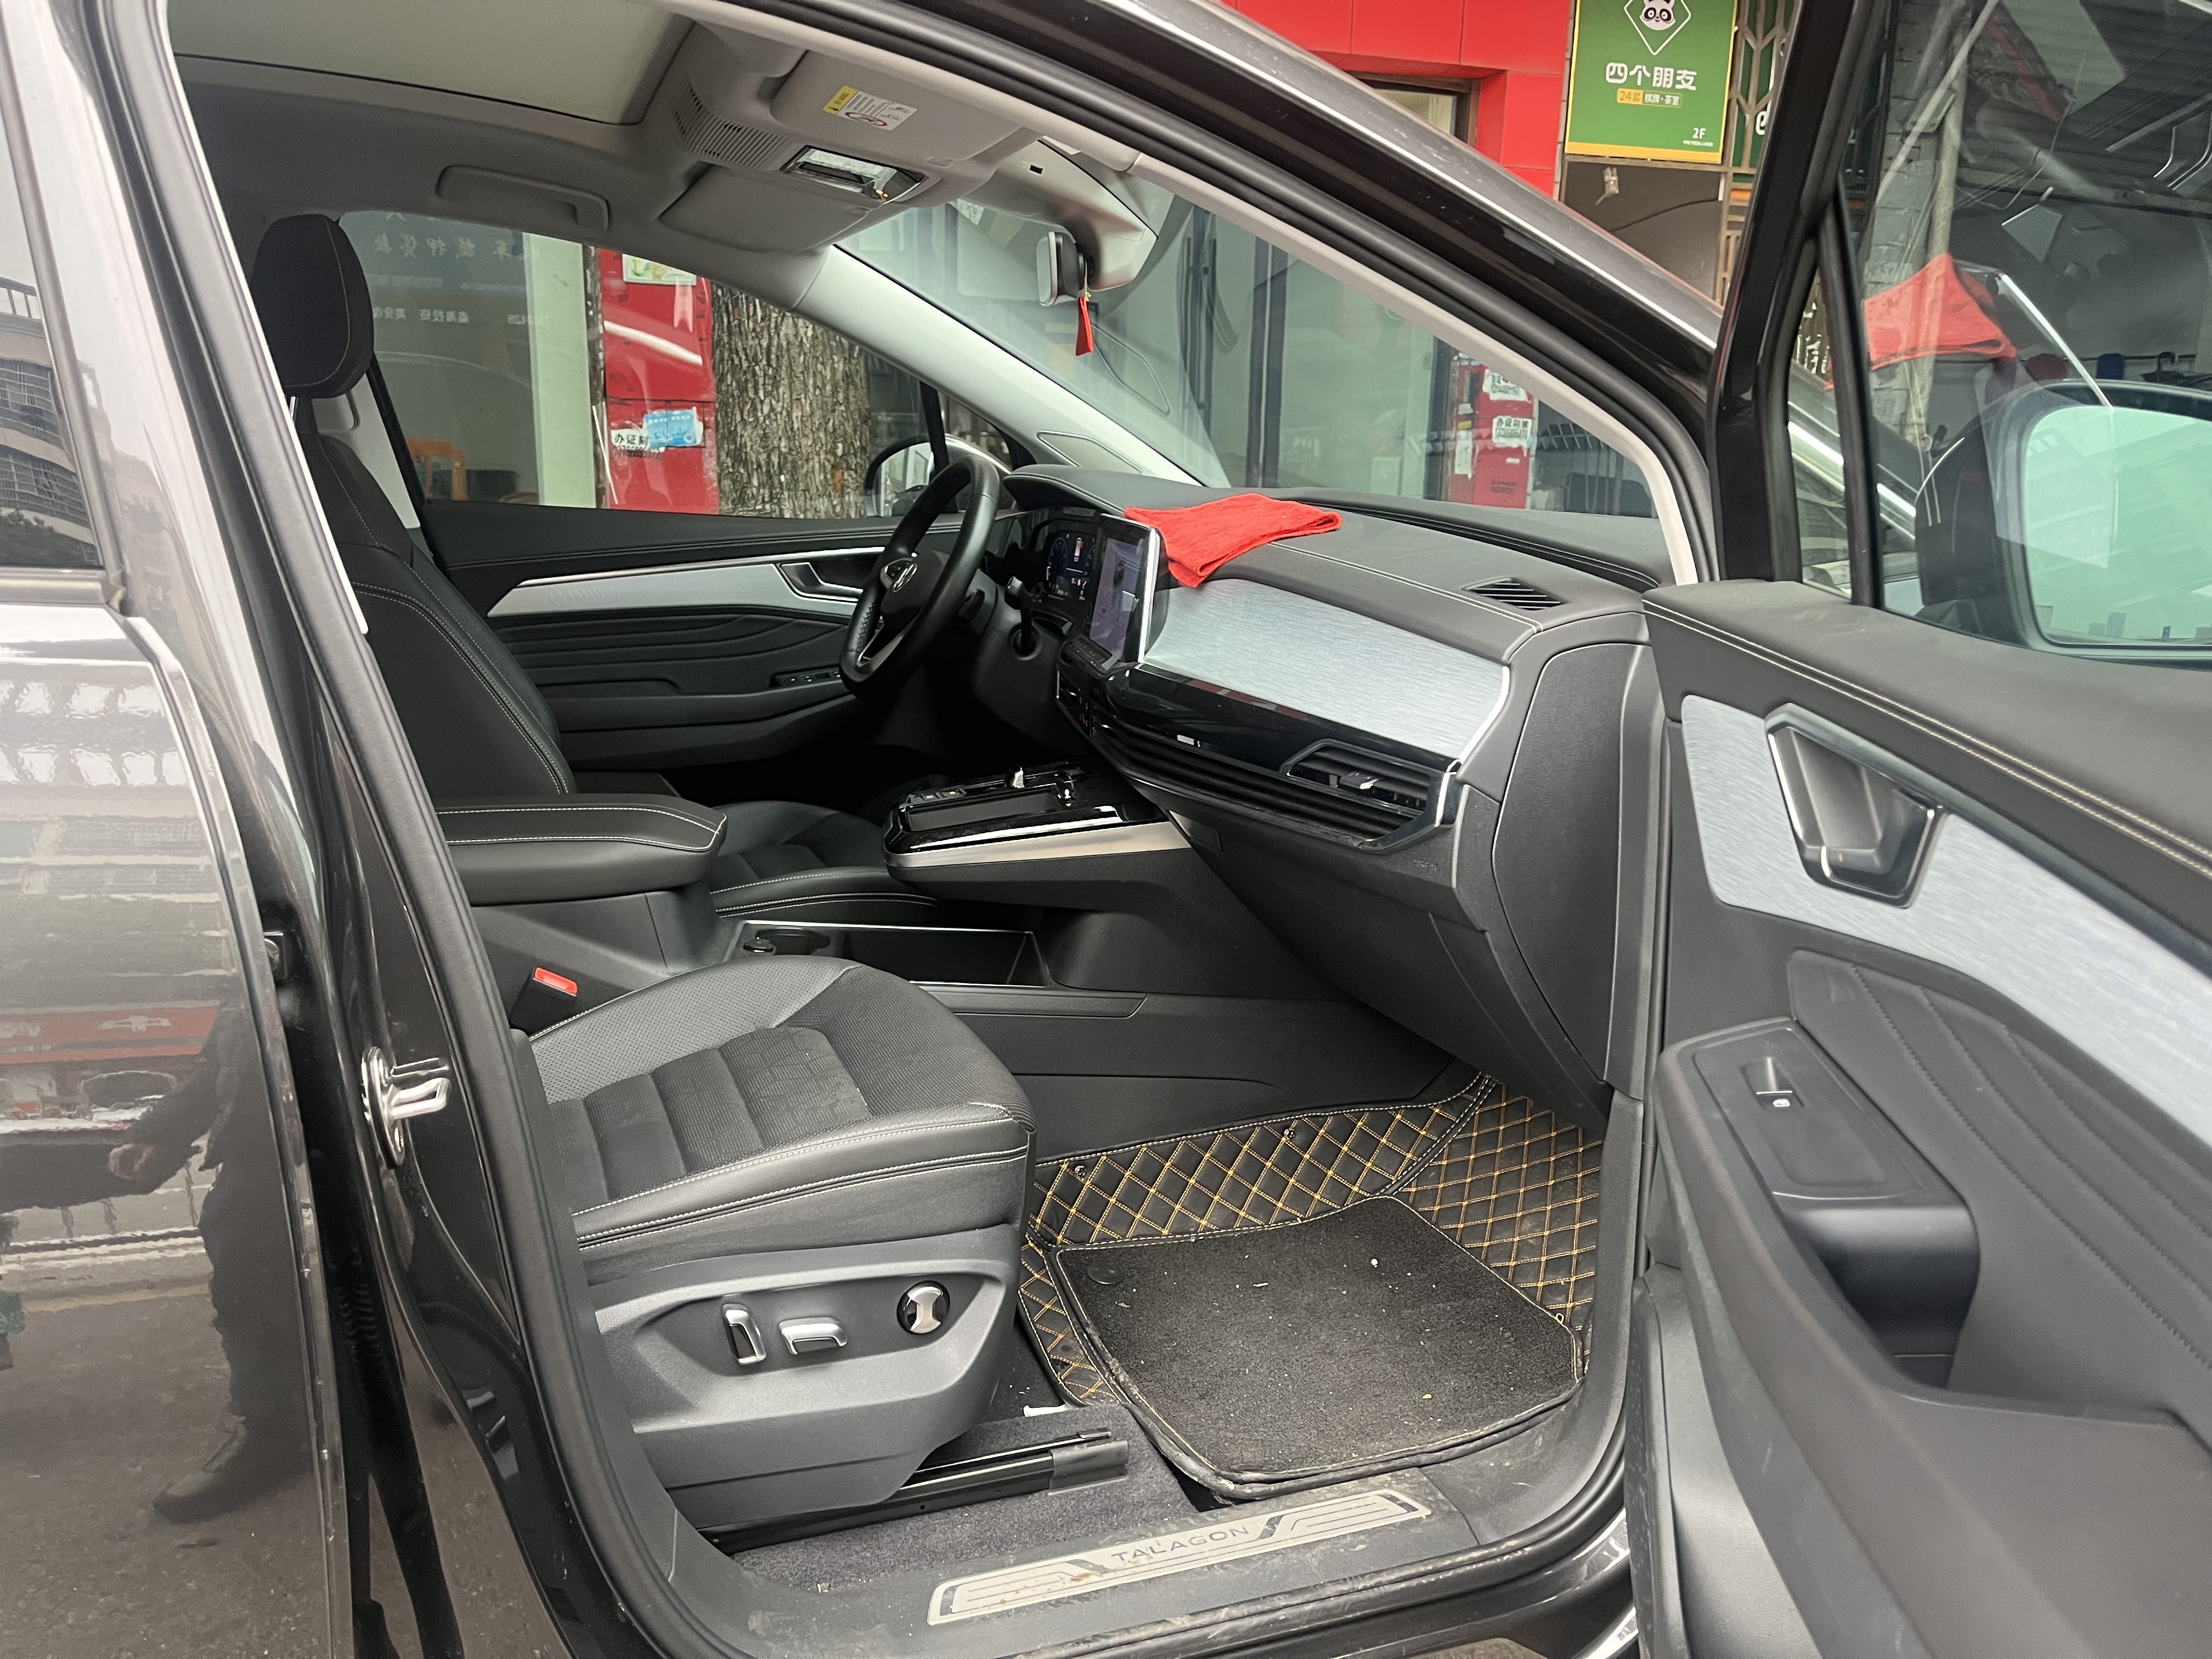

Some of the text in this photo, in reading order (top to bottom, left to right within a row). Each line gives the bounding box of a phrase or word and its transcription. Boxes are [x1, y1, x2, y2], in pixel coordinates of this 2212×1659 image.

[1605, 62, 1697, 92] 四个朋友
[1692, 127, 1706, 139] 2F
[1111, 1526, 1249, 1561] TALAGON
